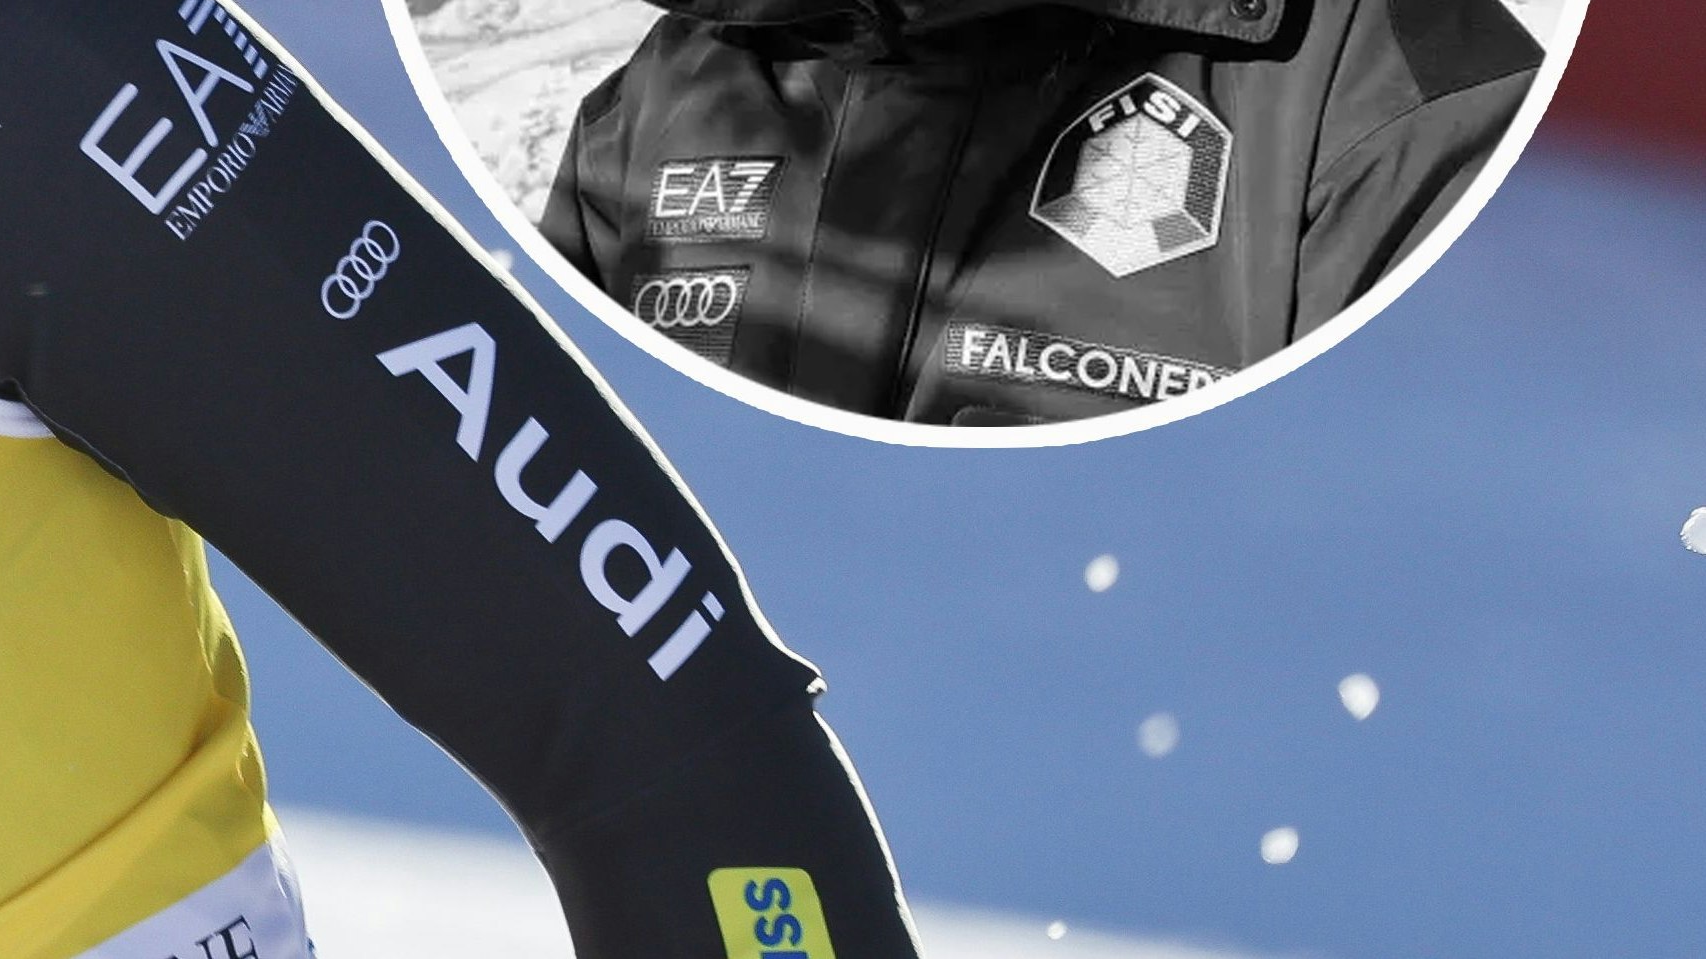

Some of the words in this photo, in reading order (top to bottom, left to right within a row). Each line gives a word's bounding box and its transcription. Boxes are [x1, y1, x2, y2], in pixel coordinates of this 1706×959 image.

[1088, 90, 1201, 139] FISI
[165, 130, 257, 241] EMPORIO
[655, 162, 776, 218] EA7
[375, 321, 727, 683] Audi
